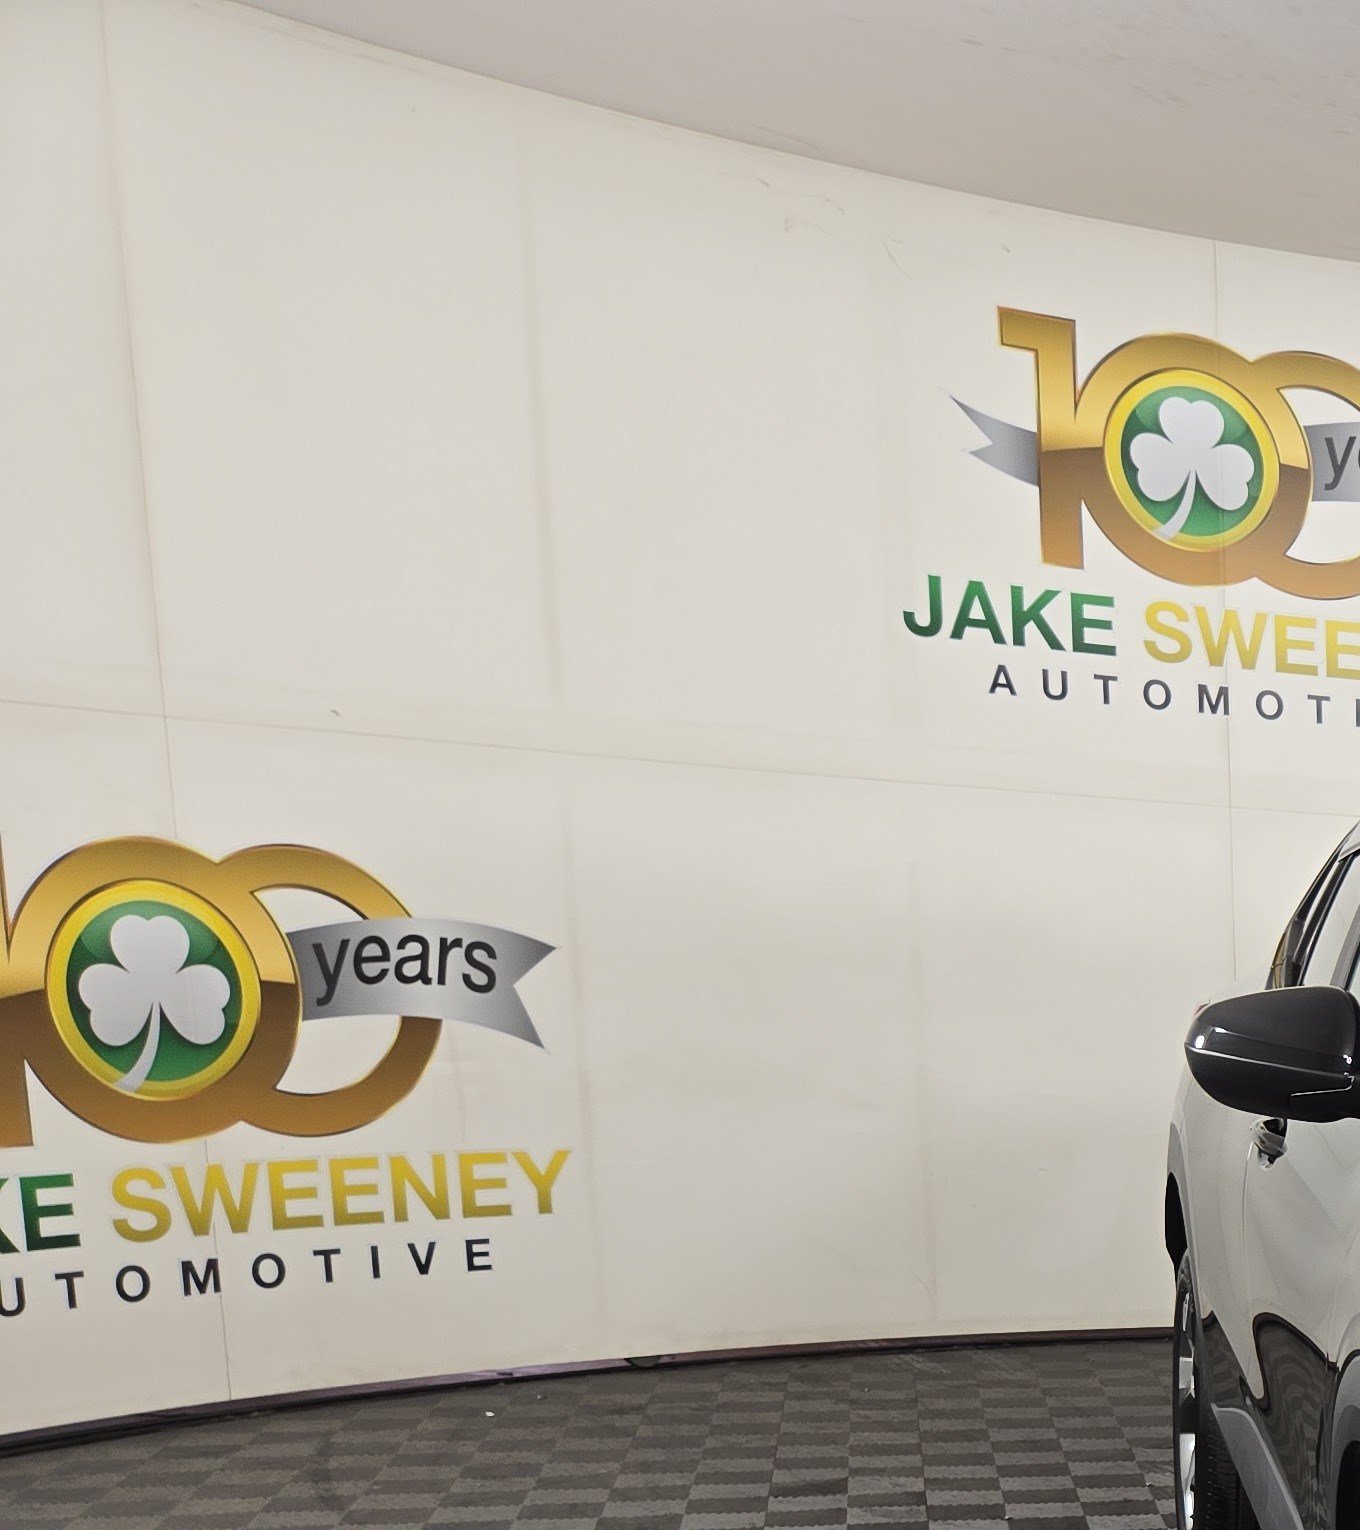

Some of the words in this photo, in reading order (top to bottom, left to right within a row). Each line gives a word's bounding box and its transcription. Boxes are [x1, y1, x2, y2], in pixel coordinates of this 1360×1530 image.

[903, 574, 1117, 658] JAKE
[311, 934, 499, 1006] years
[110, 1149, 570, 1243] SWEENEY
[0, 1238, 494, 1317] UTOMOTIVE
